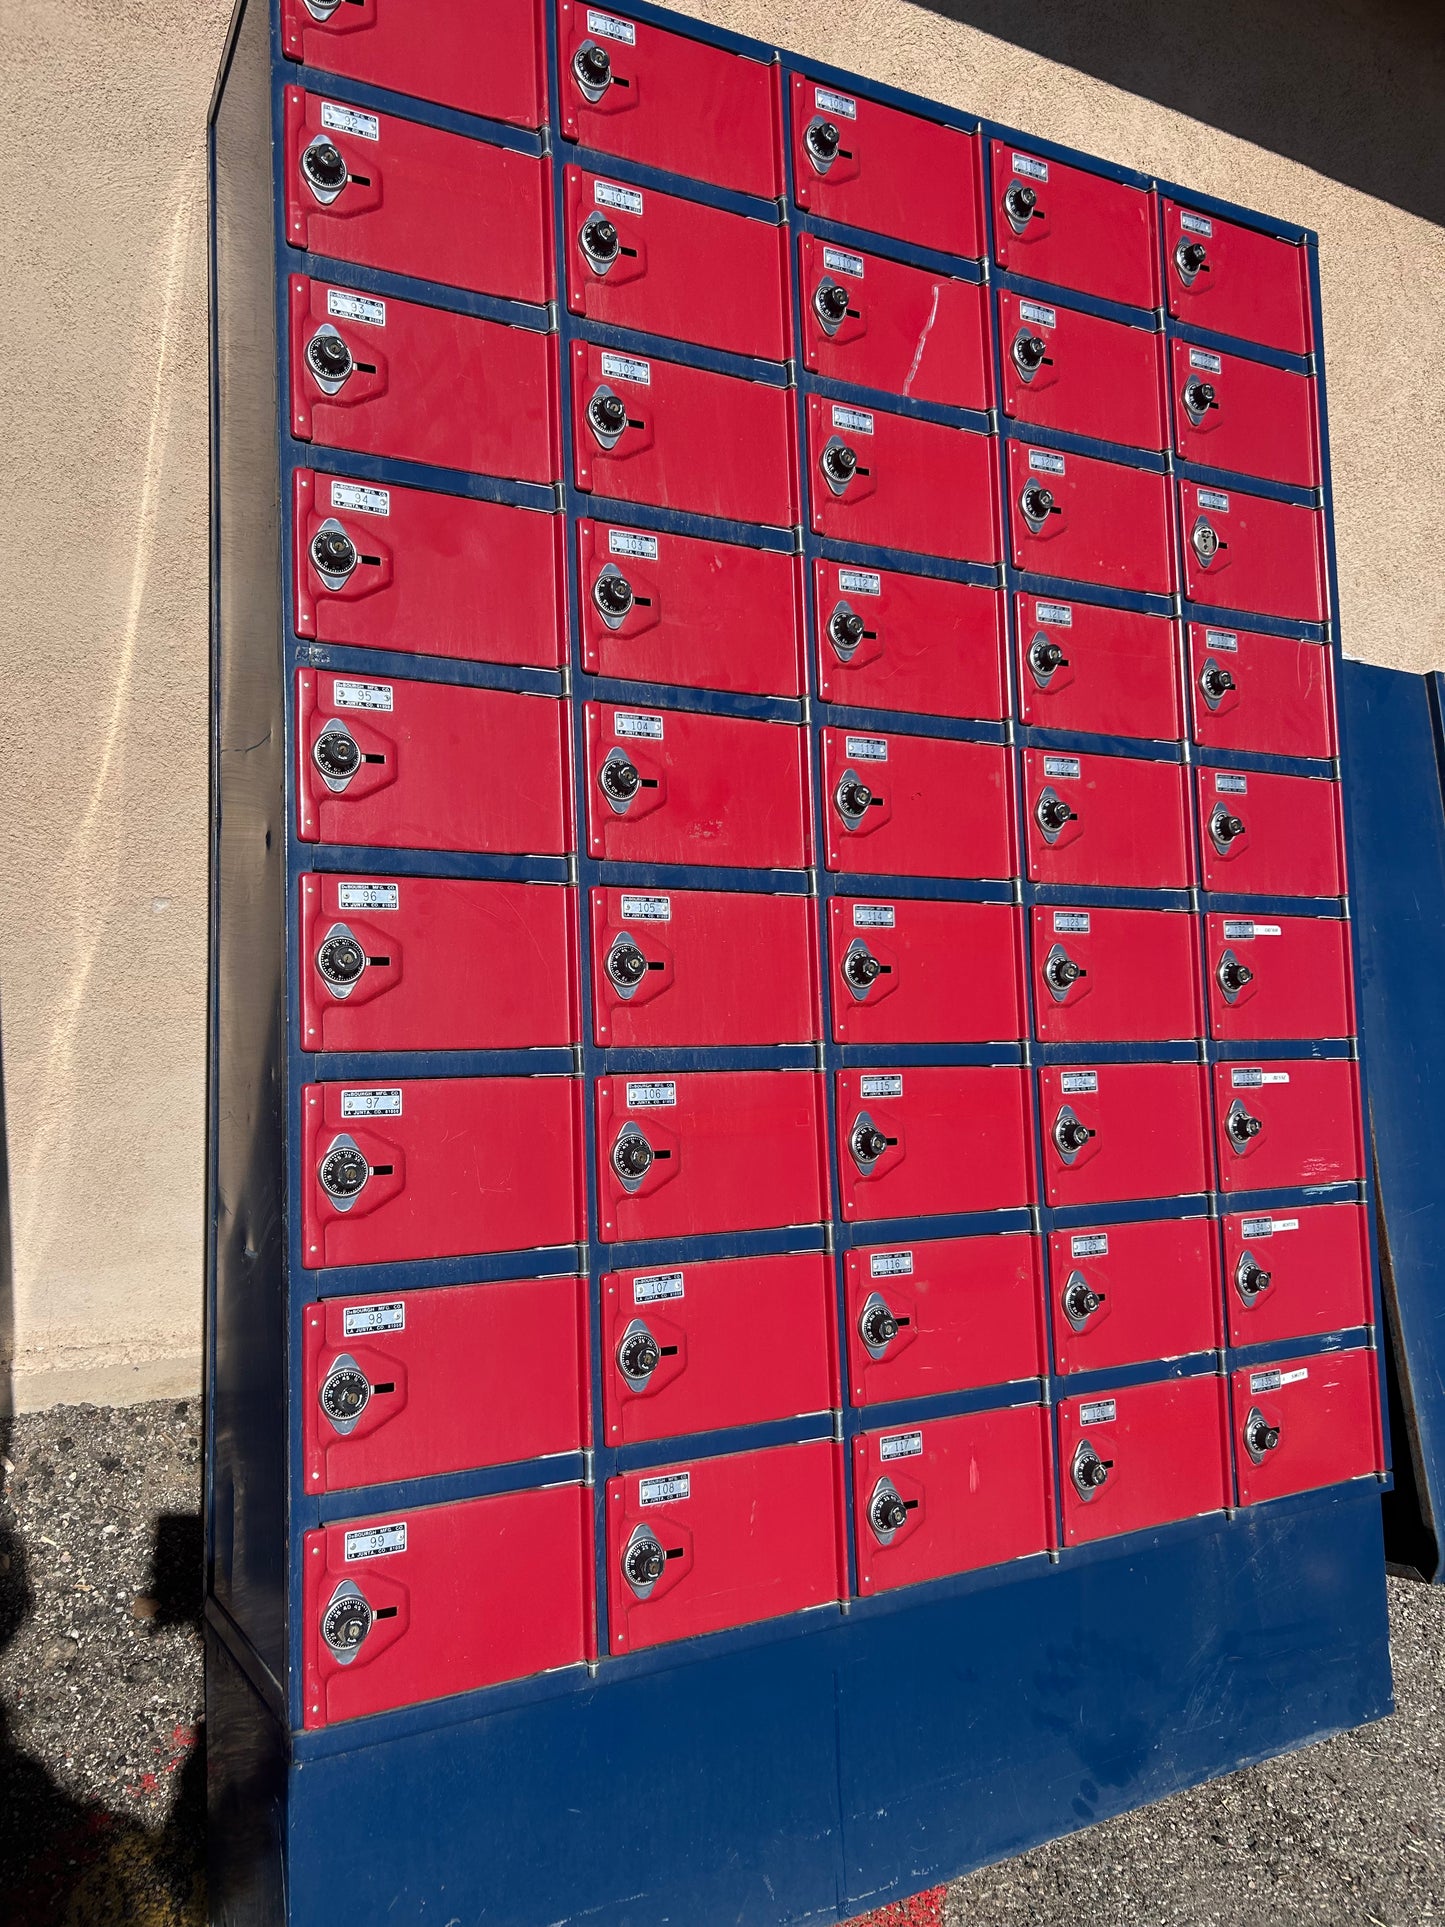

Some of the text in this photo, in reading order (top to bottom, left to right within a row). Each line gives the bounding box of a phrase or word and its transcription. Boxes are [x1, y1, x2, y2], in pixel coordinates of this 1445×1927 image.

[603, 20, 620, 34] 100
[829, 97, 843, 109] 109
[344, 115, 357, 128] 92
[611, 191, 627, 204] 101
[837, 256, 851, 269] 110
[350, 301, 364, 314] 93
[618, 362, 635, 375] 102
[846, 414, 860, 425] 111
[354, 492, 367, 504] 94
[626, 538, 642, 550] 103
[853, 577, 867, 587] 112
[1048, 609, 1060, 619] 121
[357, 689, 371, 701] 95
[631, 720, 648, 731] 104
[860, 743, 874, 753] 113
[1056, 762, 1069, 771] 122
[362, 890, 377, 901] 96
[638, 902, 655, 912] 105
[867, 911, 882, 920] 114
[1066, 917, 1079, 926] 123
[875, 1081, 889, 1090] 115
[1073, 1077, 1086, 1086] 124
[644, 1088, 660, 1099] 106
[365, 1097, 379, 1108] 97
[1084, 1240, 1096, 1250] 125
[885, 1259, 899, 1269] 116
[651, 1281, 668, 1294] 107
[368, 1312, 382, 1324] 98
[1092, 1407, 1105, 1417] 126
[895, 1439, 908, 1451] 117
[657, 1482, 674, 1495] 108
[369, 1534, 384, 1548] 99
